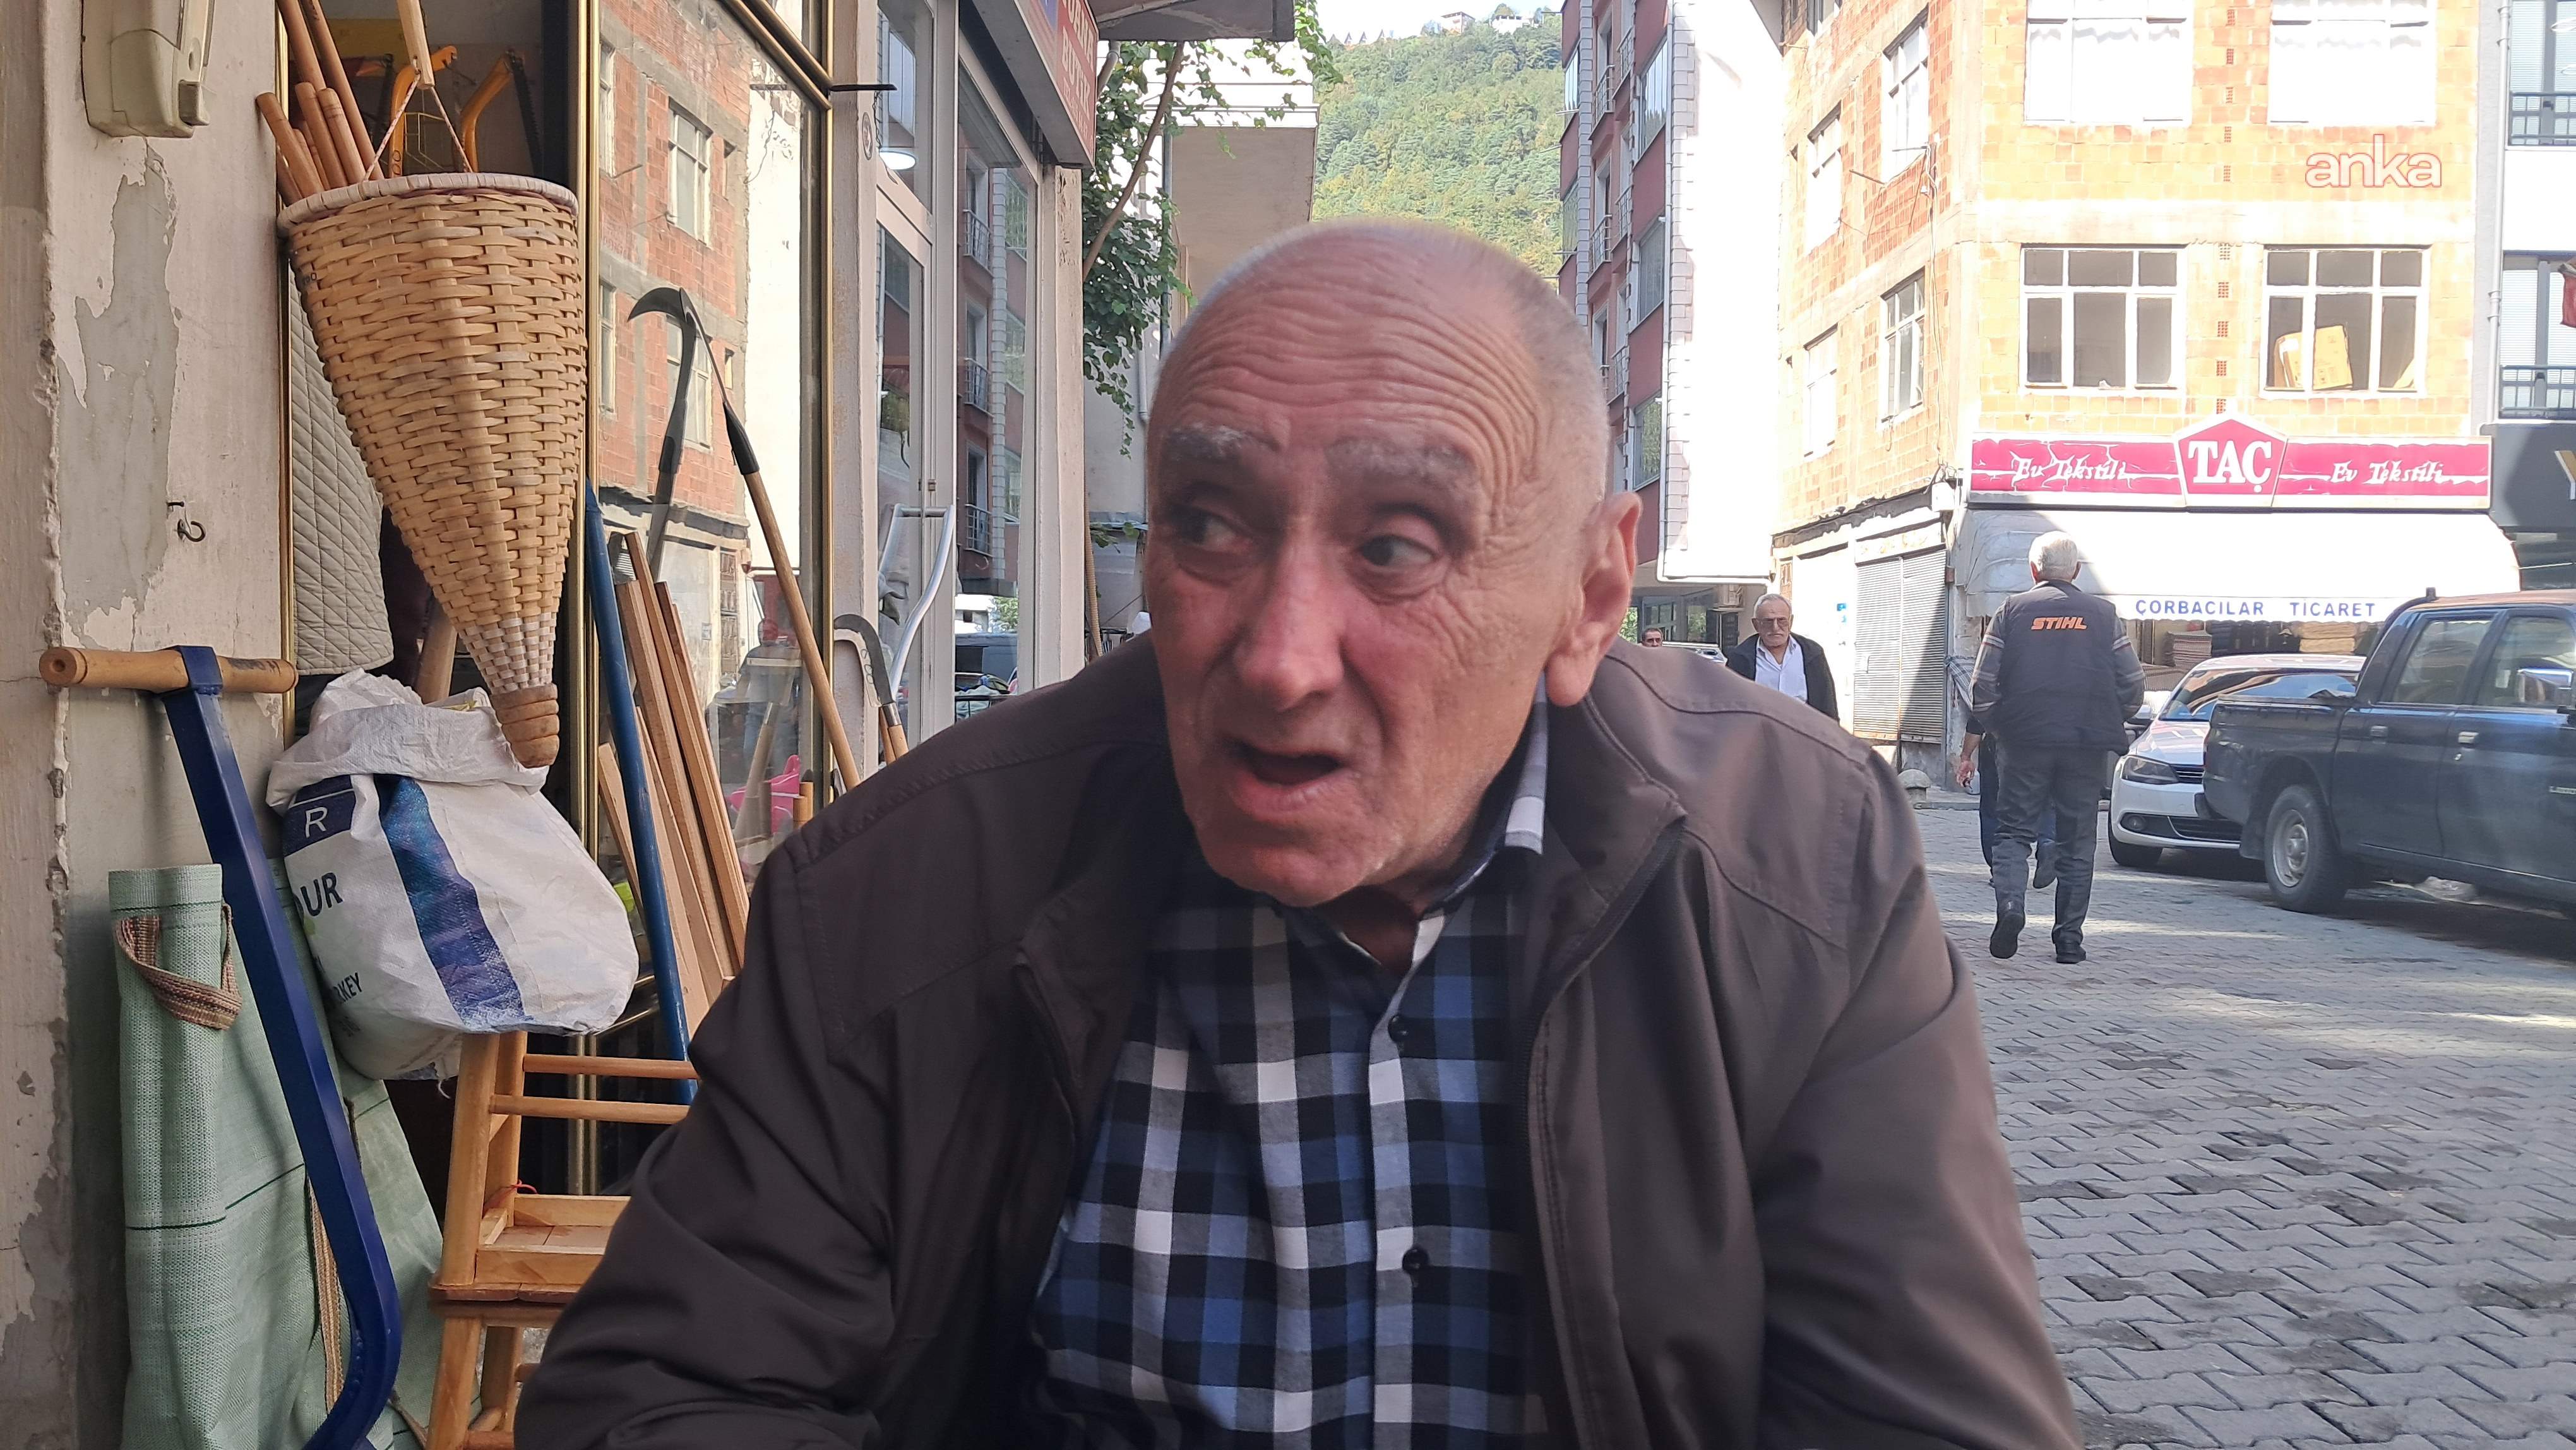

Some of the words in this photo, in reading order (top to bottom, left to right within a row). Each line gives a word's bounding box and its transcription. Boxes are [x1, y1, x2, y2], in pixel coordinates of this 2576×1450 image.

[2015, 457, 2044, 480] Ev
[2188, 440, 2271, 493] TAÇ
[2330, 460, 2358, 483] Ev
[2135, 599, 2264, 616] ÇORBACILAR
[2290, 599, 2375, 616] TİCARET
[2031, 616, 2087, 630] STIHL
[305, 806, 328, 838] R
